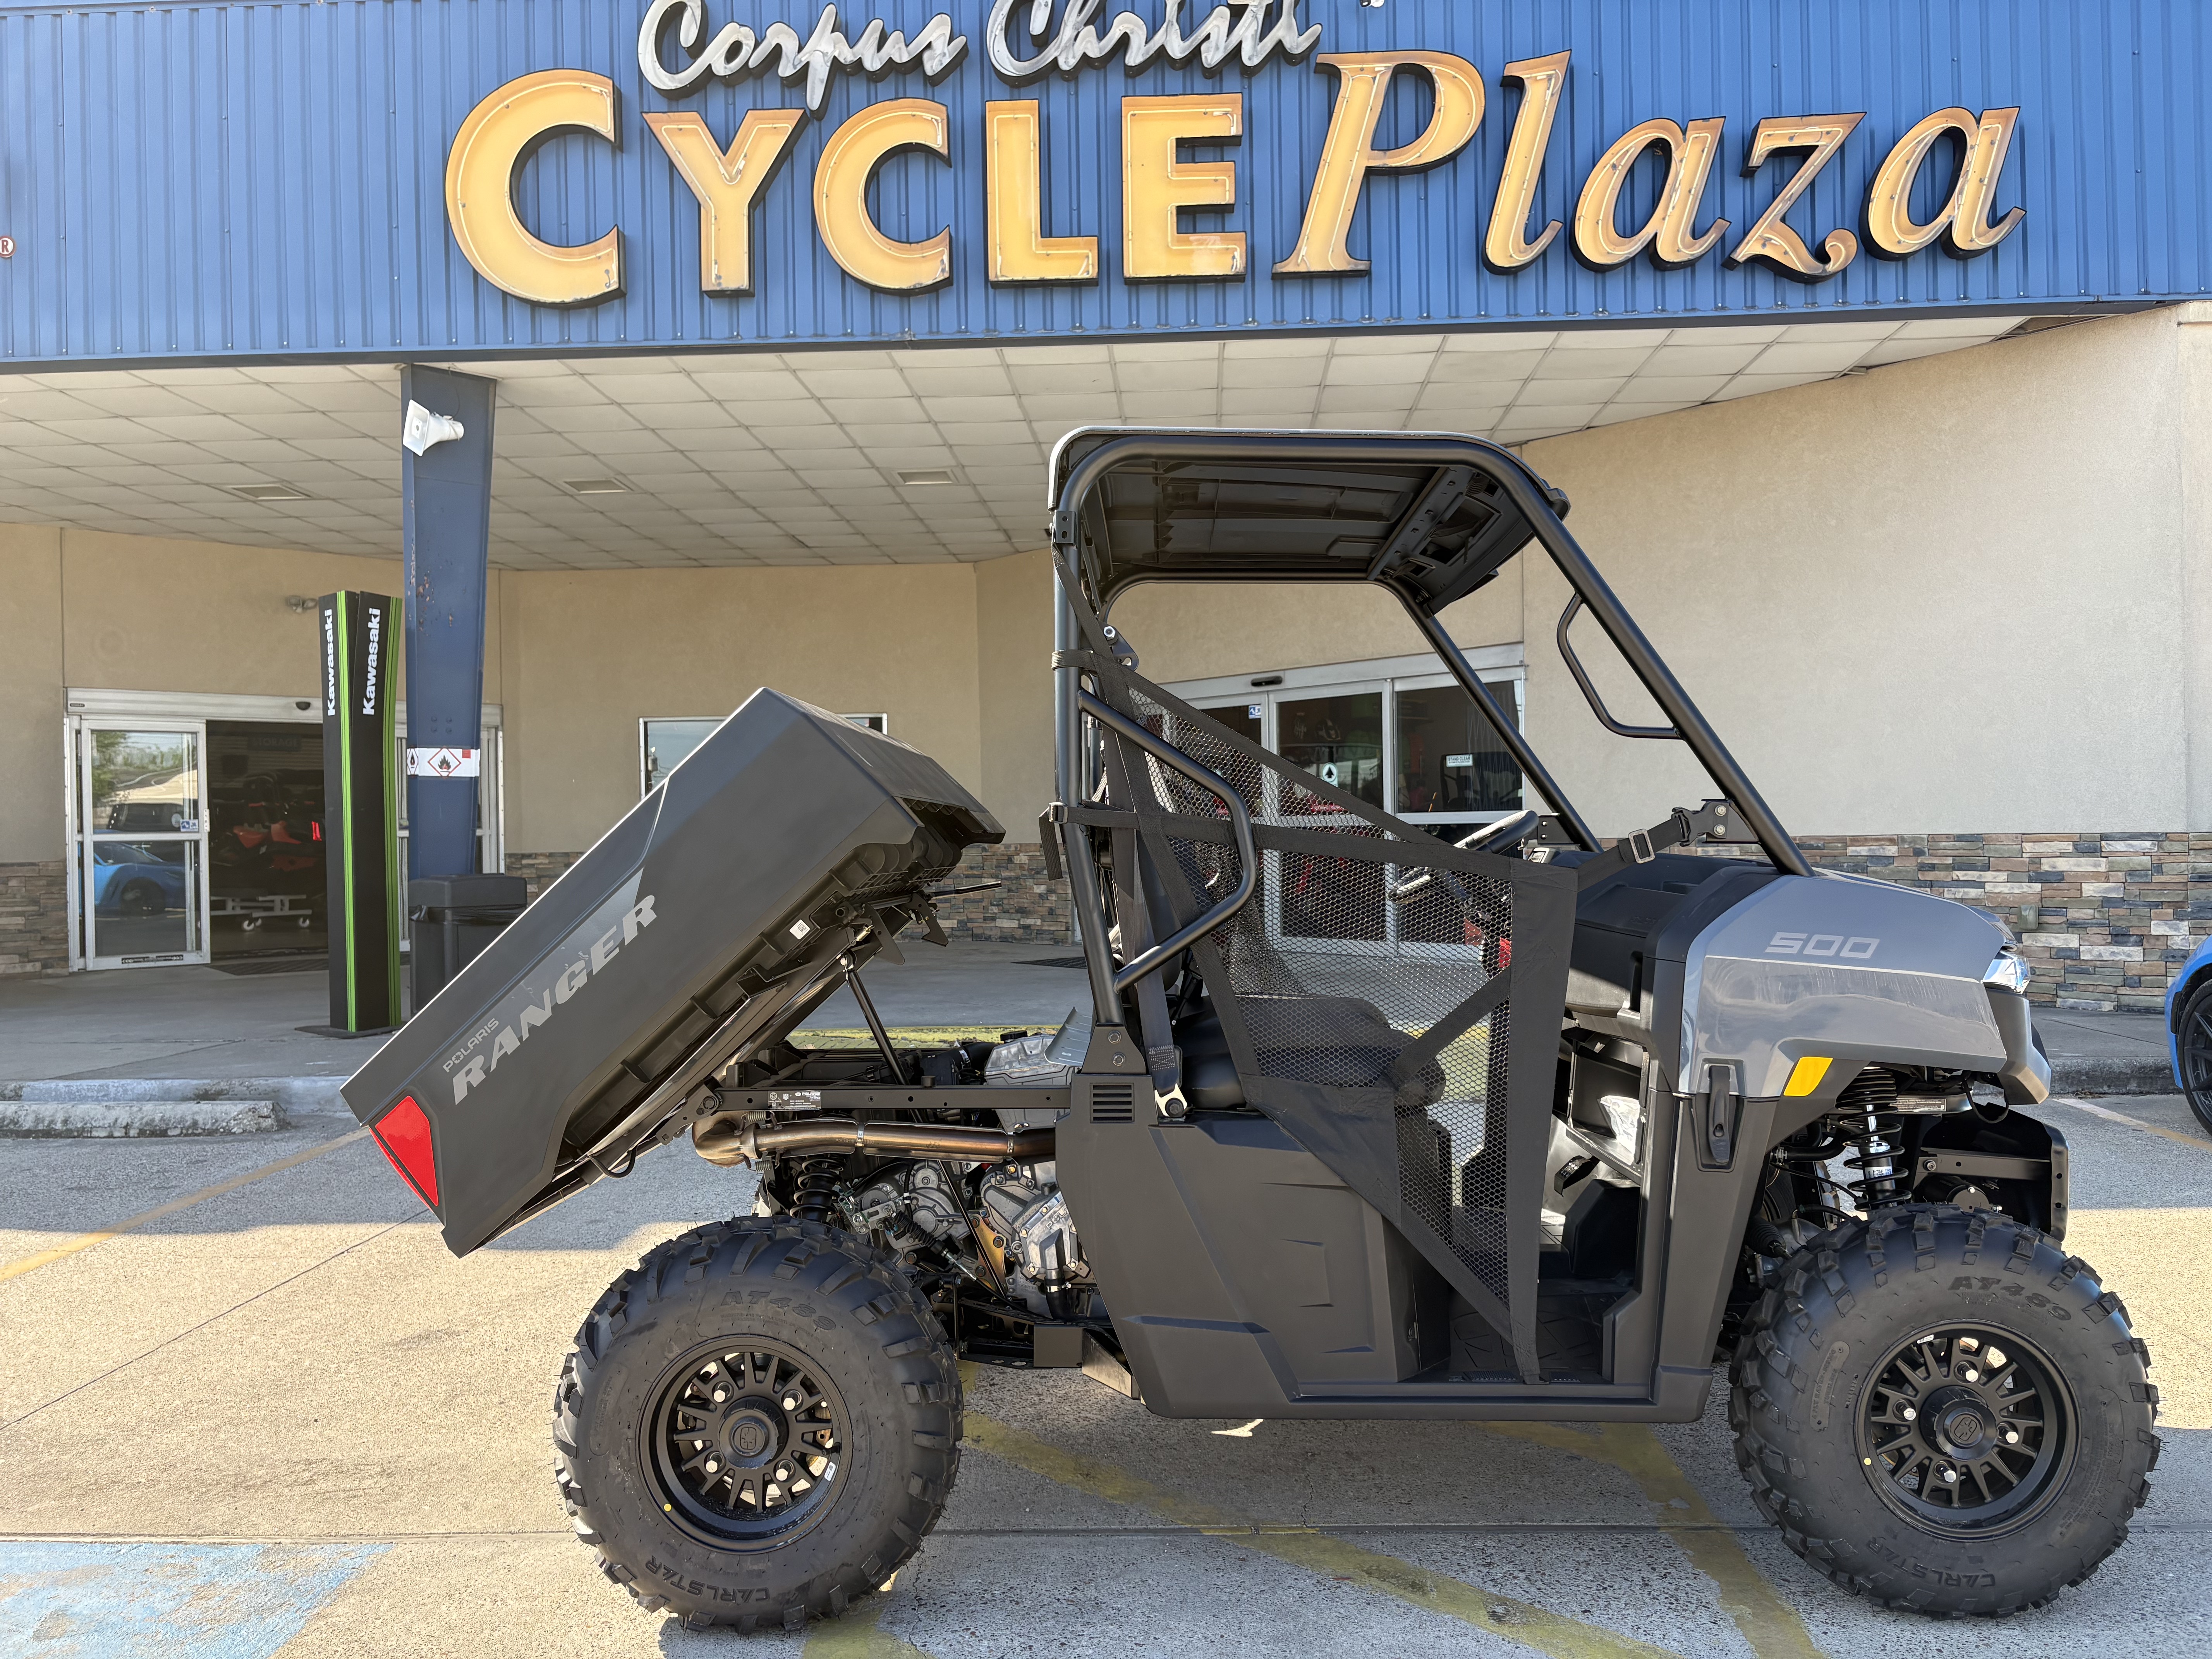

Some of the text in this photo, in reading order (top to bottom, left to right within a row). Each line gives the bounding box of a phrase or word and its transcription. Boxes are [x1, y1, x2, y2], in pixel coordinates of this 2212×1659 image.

[638, 0, 1322, 119] Corpus Christi
[445, 48, 2026, 308] CYCLE Plaza
[324, 609, 335, 716] Kawasaki
[362, 608, 381, 715] Kawasaki
[1765, 932, 1880, 958] 500
[452, 895, 657, 1105] RANGER
[443, 1018, 499, 1073] POLARIS
[720, 1290, 836, 1330] AT489
[1948, 1276, 2071, 1321] AT489
[645, 1555, 770, 1603] CARLSTAR
[1865, 1537, 1996, 1587] CARLSTAR
